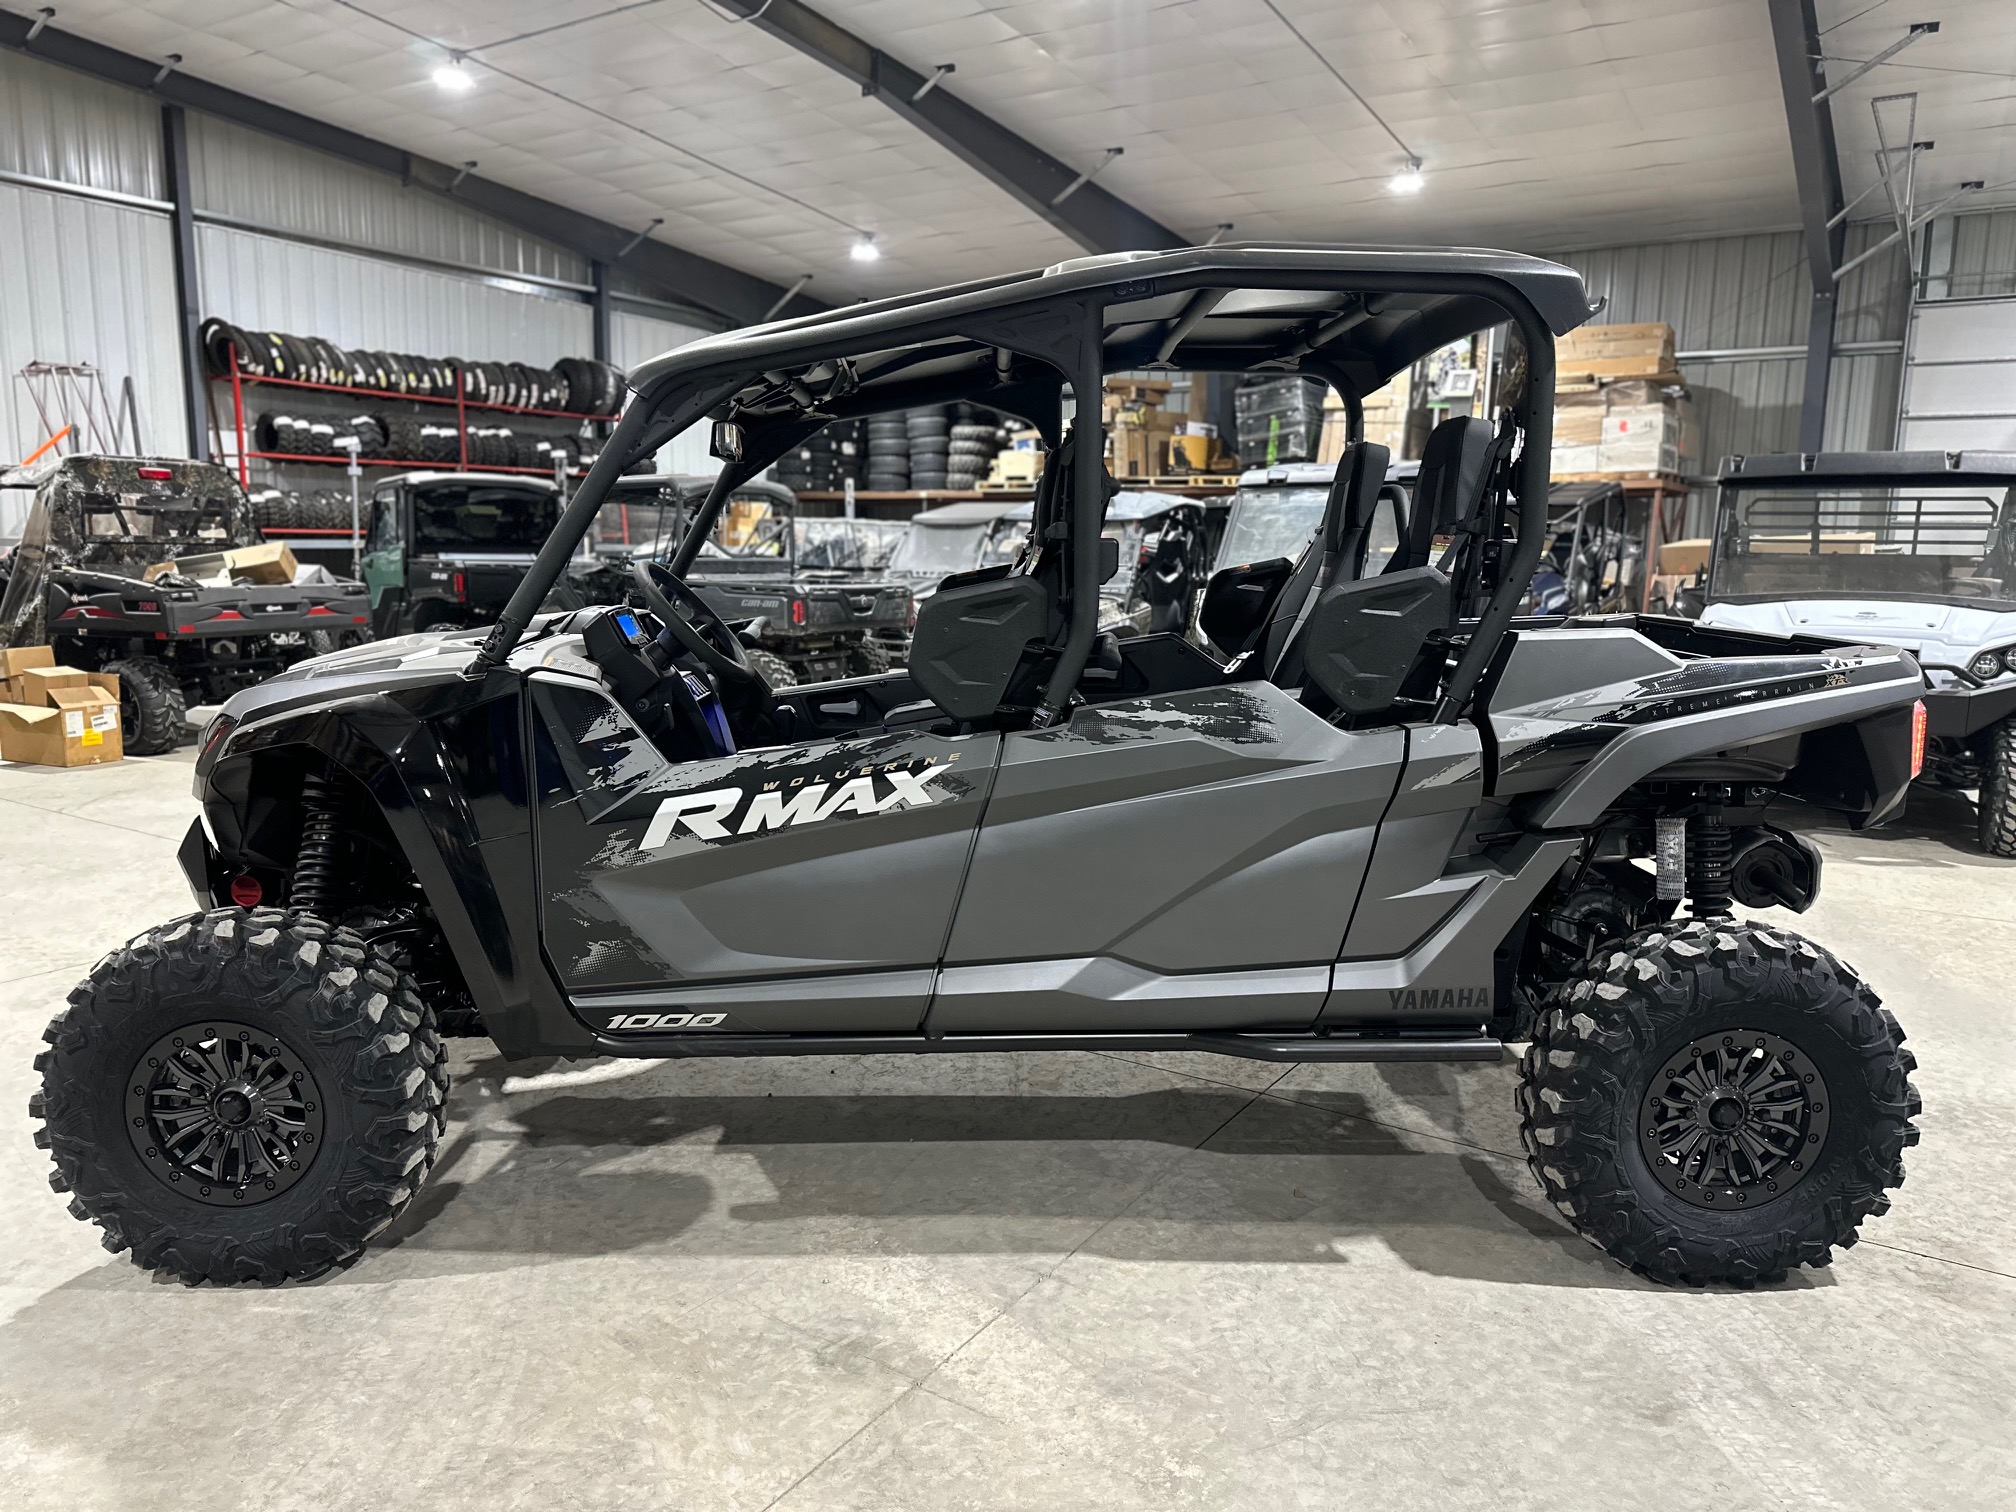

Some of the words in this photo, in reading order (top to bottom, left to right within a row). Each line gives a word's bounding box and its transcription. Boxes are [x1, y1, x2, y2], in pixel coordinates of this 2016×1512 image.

[741, 598, 779, 608] can-am
[1652, 698, 1721, 717] XTREME
[638, 763, 954, 851] RMAX
[1388, 987, 1489, 1010] YAMAHA
[606, 1013, 728, 1029] 1000
